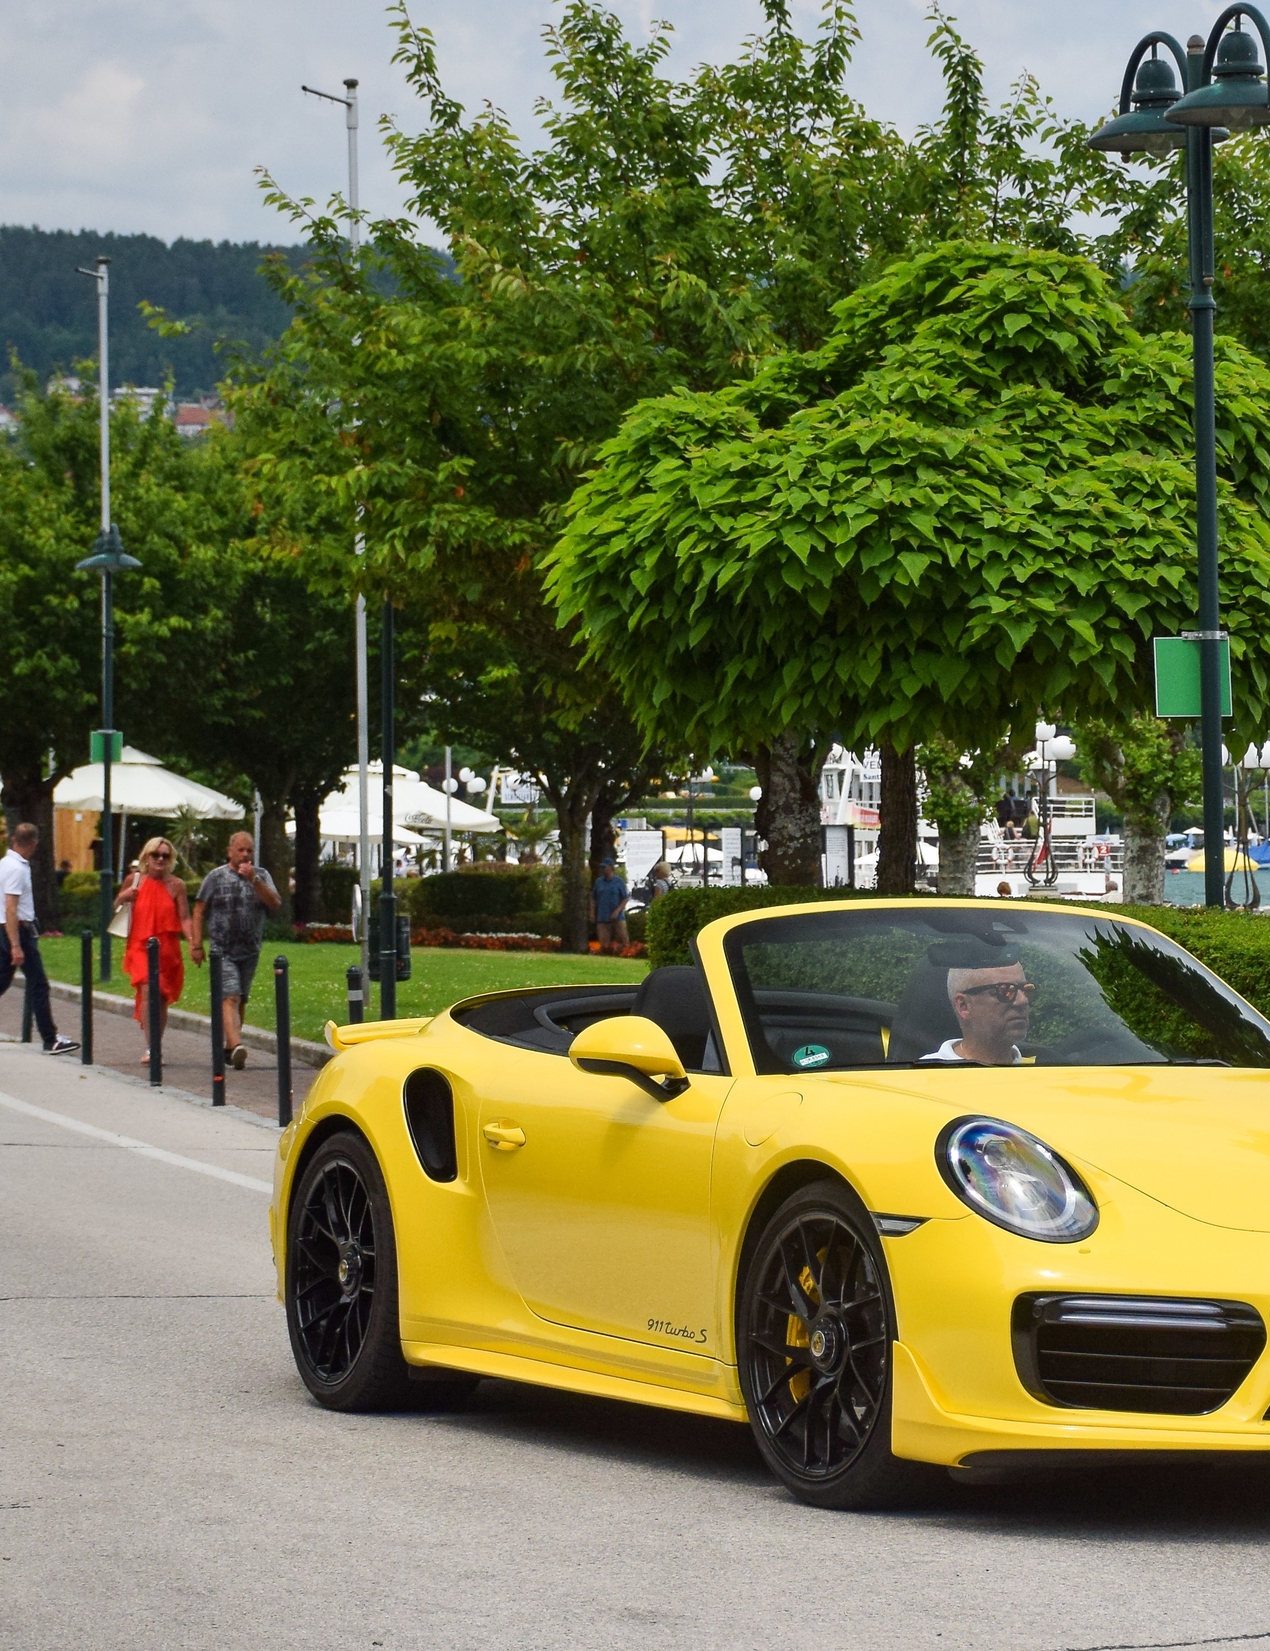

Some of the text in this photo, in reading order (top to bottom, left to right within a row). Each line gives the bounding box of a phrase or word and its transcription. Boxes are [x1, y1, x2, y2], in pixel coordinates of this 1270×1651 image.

[1100, 846, 1107, 854] 2
[805, 1046, 815, 1056] 4
[647, 1318, 664, 1332] 911
[694, 1328, 708, 1344] S
